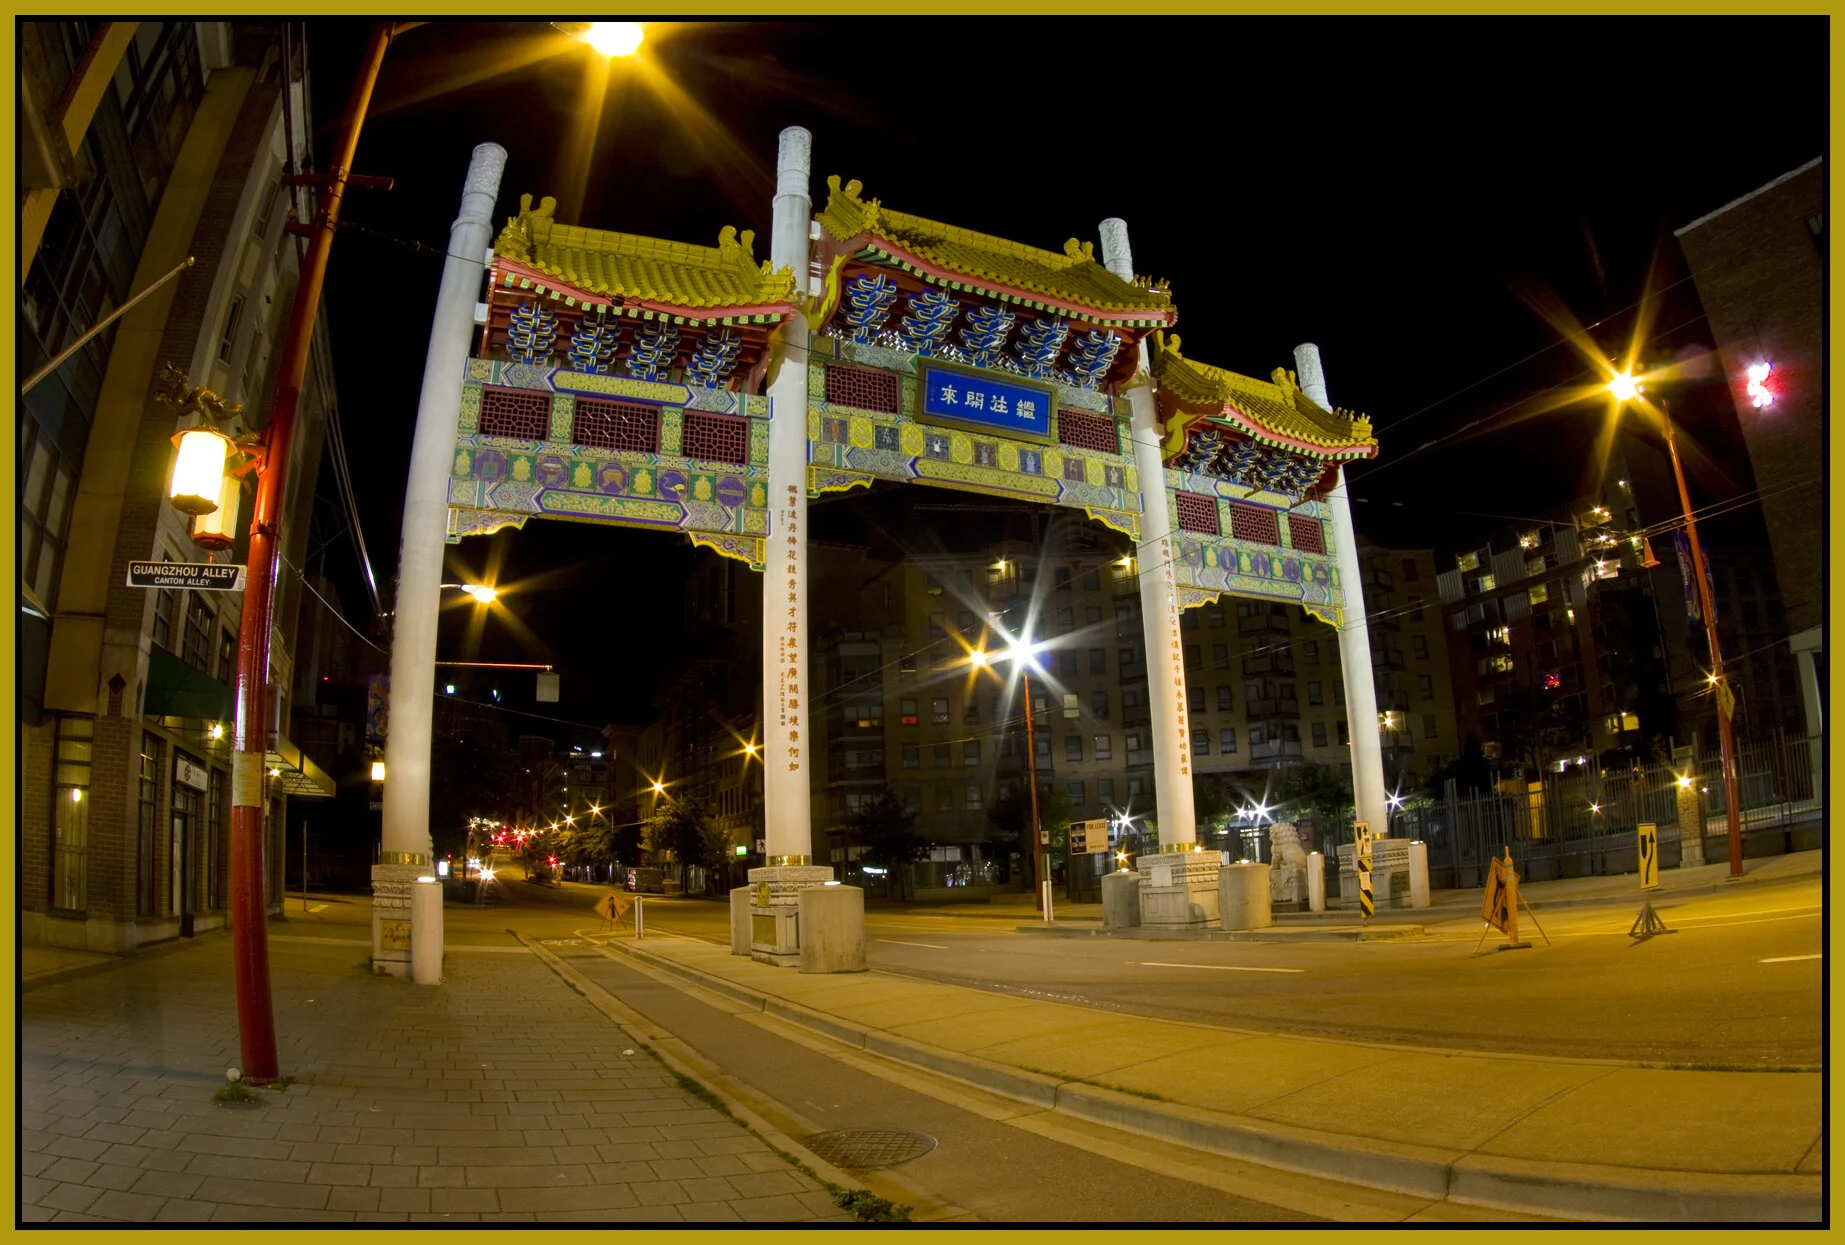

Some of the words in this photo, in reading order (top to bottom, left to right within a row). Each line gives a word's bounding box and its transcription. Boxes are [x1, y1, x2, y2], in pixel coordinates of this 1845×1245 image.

[133, 565, 198, 576] GUANGZHOU
[202, 568, 235, 578] ALLEY
[154, 577, 185, 585] CANTON
